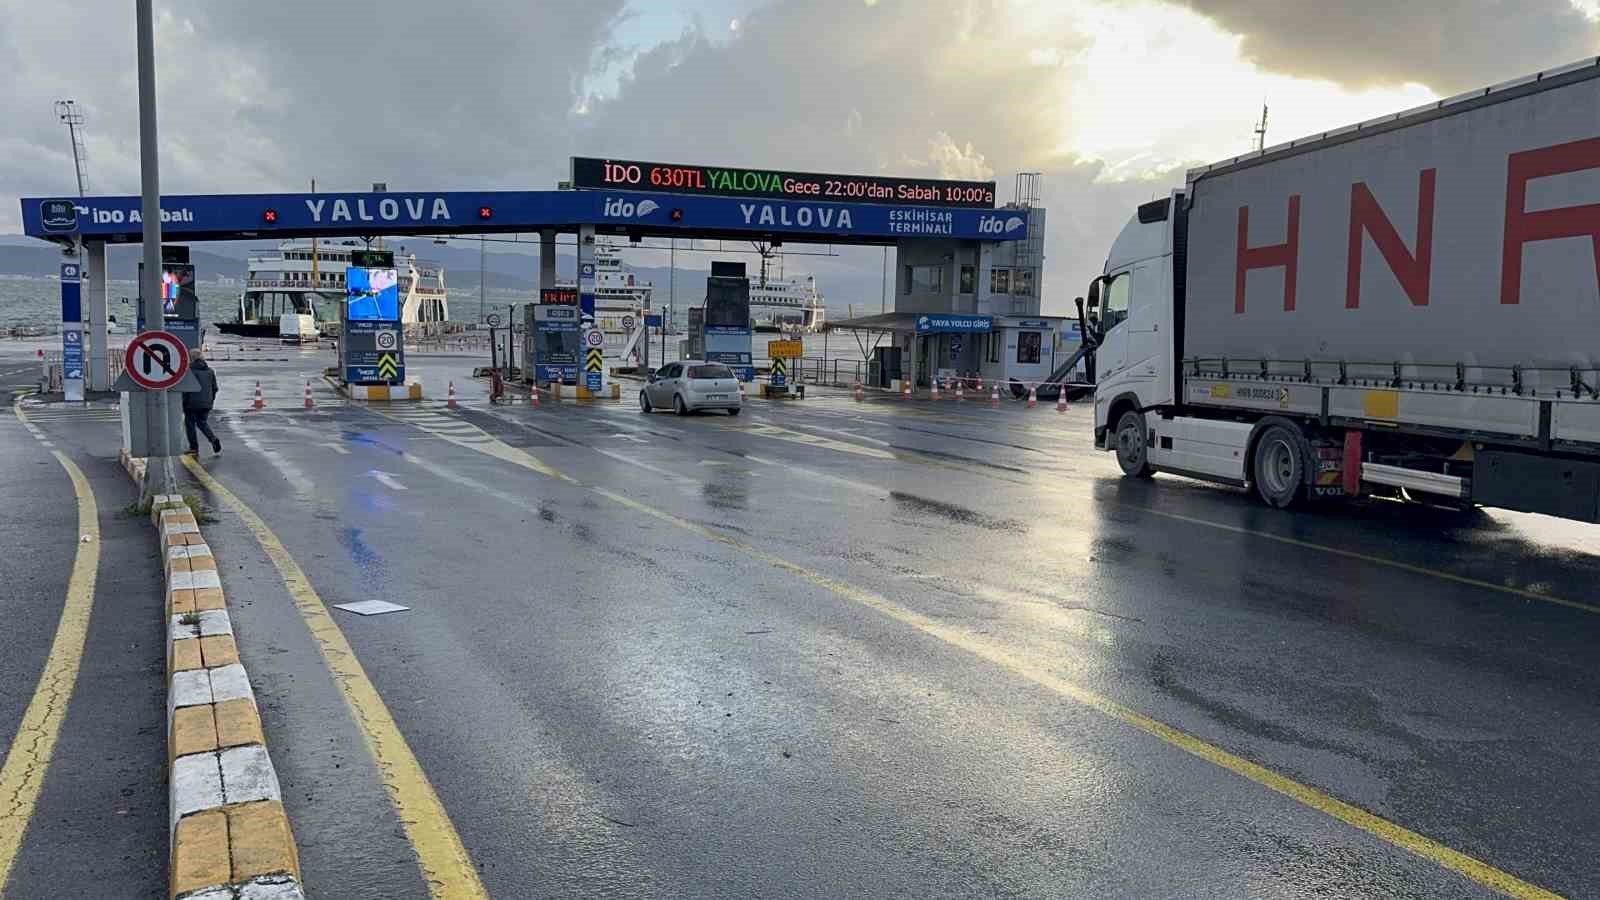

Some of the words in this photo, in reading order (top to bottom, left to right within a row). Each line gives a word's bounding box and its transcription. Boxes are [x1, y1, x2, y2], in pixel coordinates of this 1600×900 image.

[603, 160, 642, 184] İDO
[650, 167, 706, 189] 630TL
[707, 169, 783, 192] YALOVA
[784, 178, 820, 195] Gece
[824, 180, 894, 199] 22:00'dan
[897, 184, 941, 201] Sabah
[946, 187, 993, 203] 10:00'a
[305, 198, 450, 222] YALOVA
[603, 198, 635, 218] ido
[740, 204, 853, 228] YALOVA
[889, 208, 953, 222] ESKİHİSAR
[888, 221, 953, 234] TERMİNALİ
[978, 215, 1003, 234] ido
